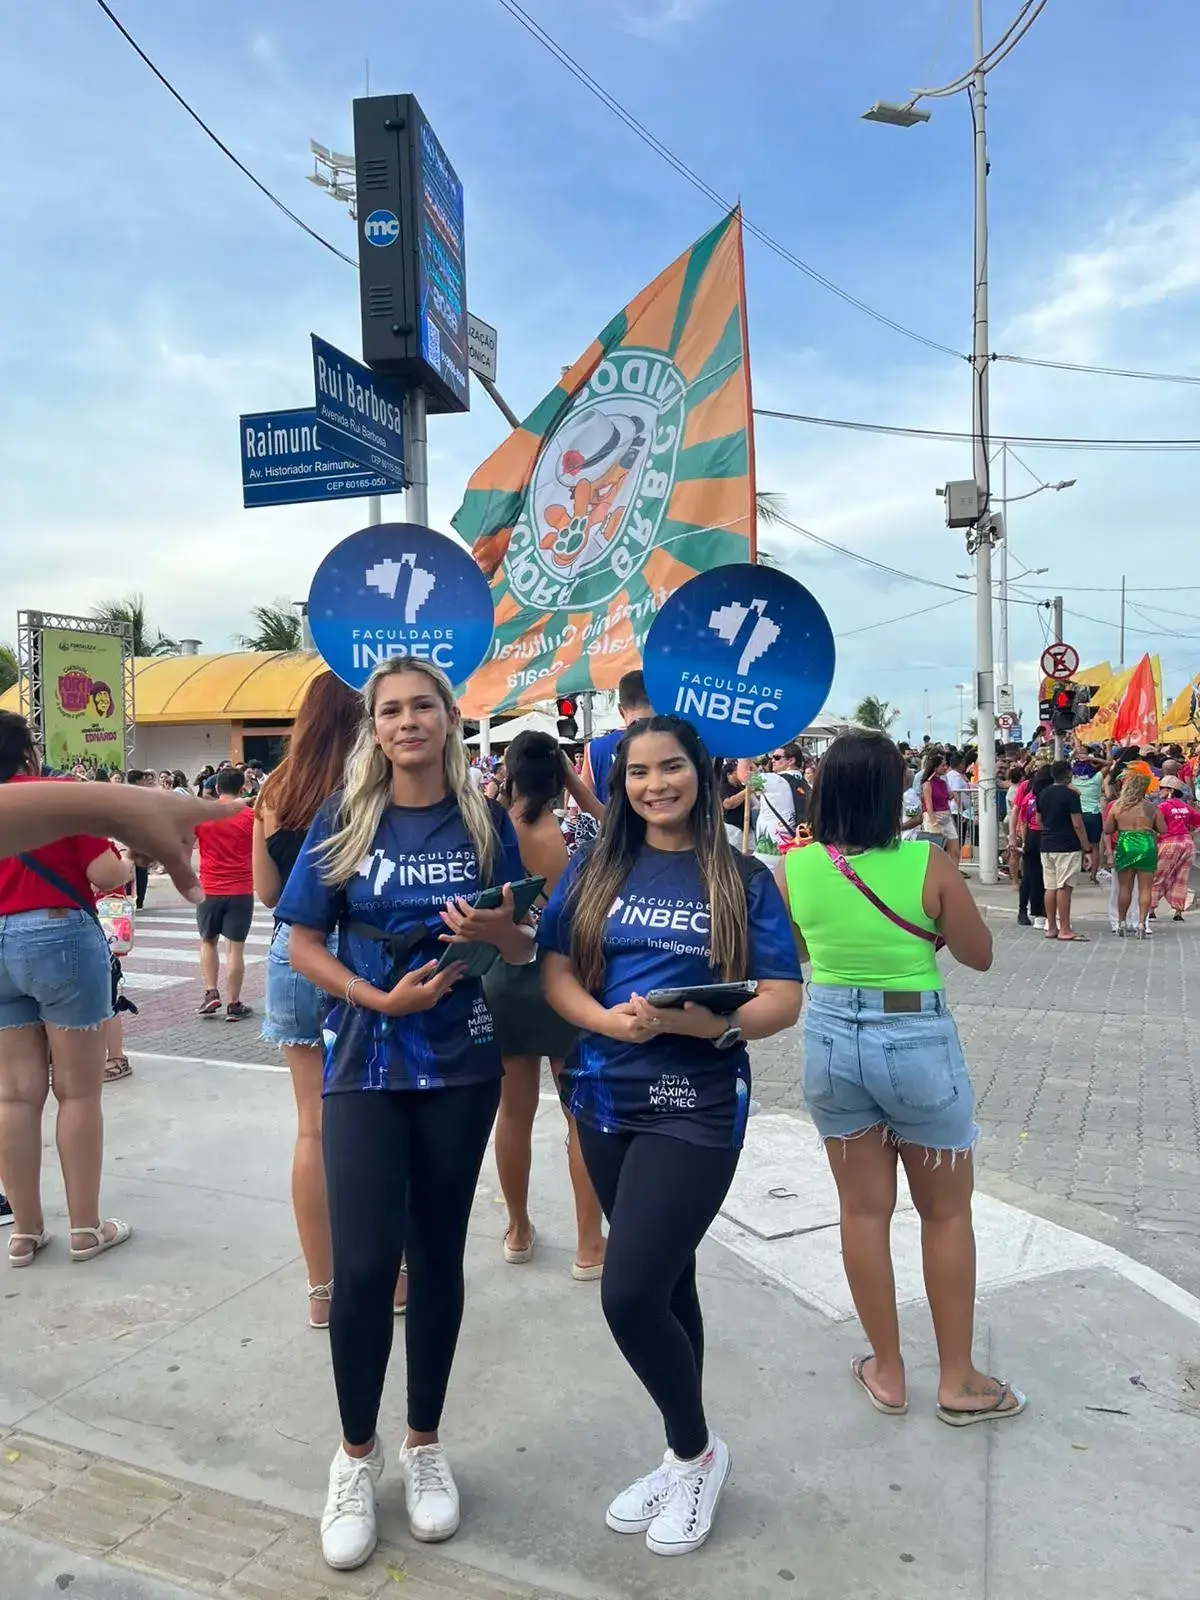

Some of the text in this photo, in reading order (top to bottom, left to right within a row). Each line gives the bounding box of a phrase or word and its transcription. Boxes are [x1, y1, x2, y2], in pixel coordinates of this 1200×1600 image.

[469, 326, 495, 351] IZAÇÃO
[468, 345, 491, 368] ÔNICA
[318, 355, 401, 435] Rui Barbosa
[321, 404, 387, 448] Avenida Rui Barbosa
[249, 468, 263, 479] Av.
[265, 463, 313, 477] Historiador
[326, 478, 387, 491] CEP 60165-050
[352, 629, 454, 640] FACULDADE
[352, 643, 454, 669] INBEC
[681, 671, 784, 700] FACULDADE
[674, 686, 779, 730] INBEC
[399, 851, 477, 863] FACULDADE
[399, 860, 477, 887] INBEC
[628, 894, 712, 911] FACULDADE
[620, 905, 712, 934] INBEC
[647, 937, 713, 958] Inteligente
[649, 1085, 697, 1097] MÁXIMA
[650, 1095, 696, 1108] NO MEC
